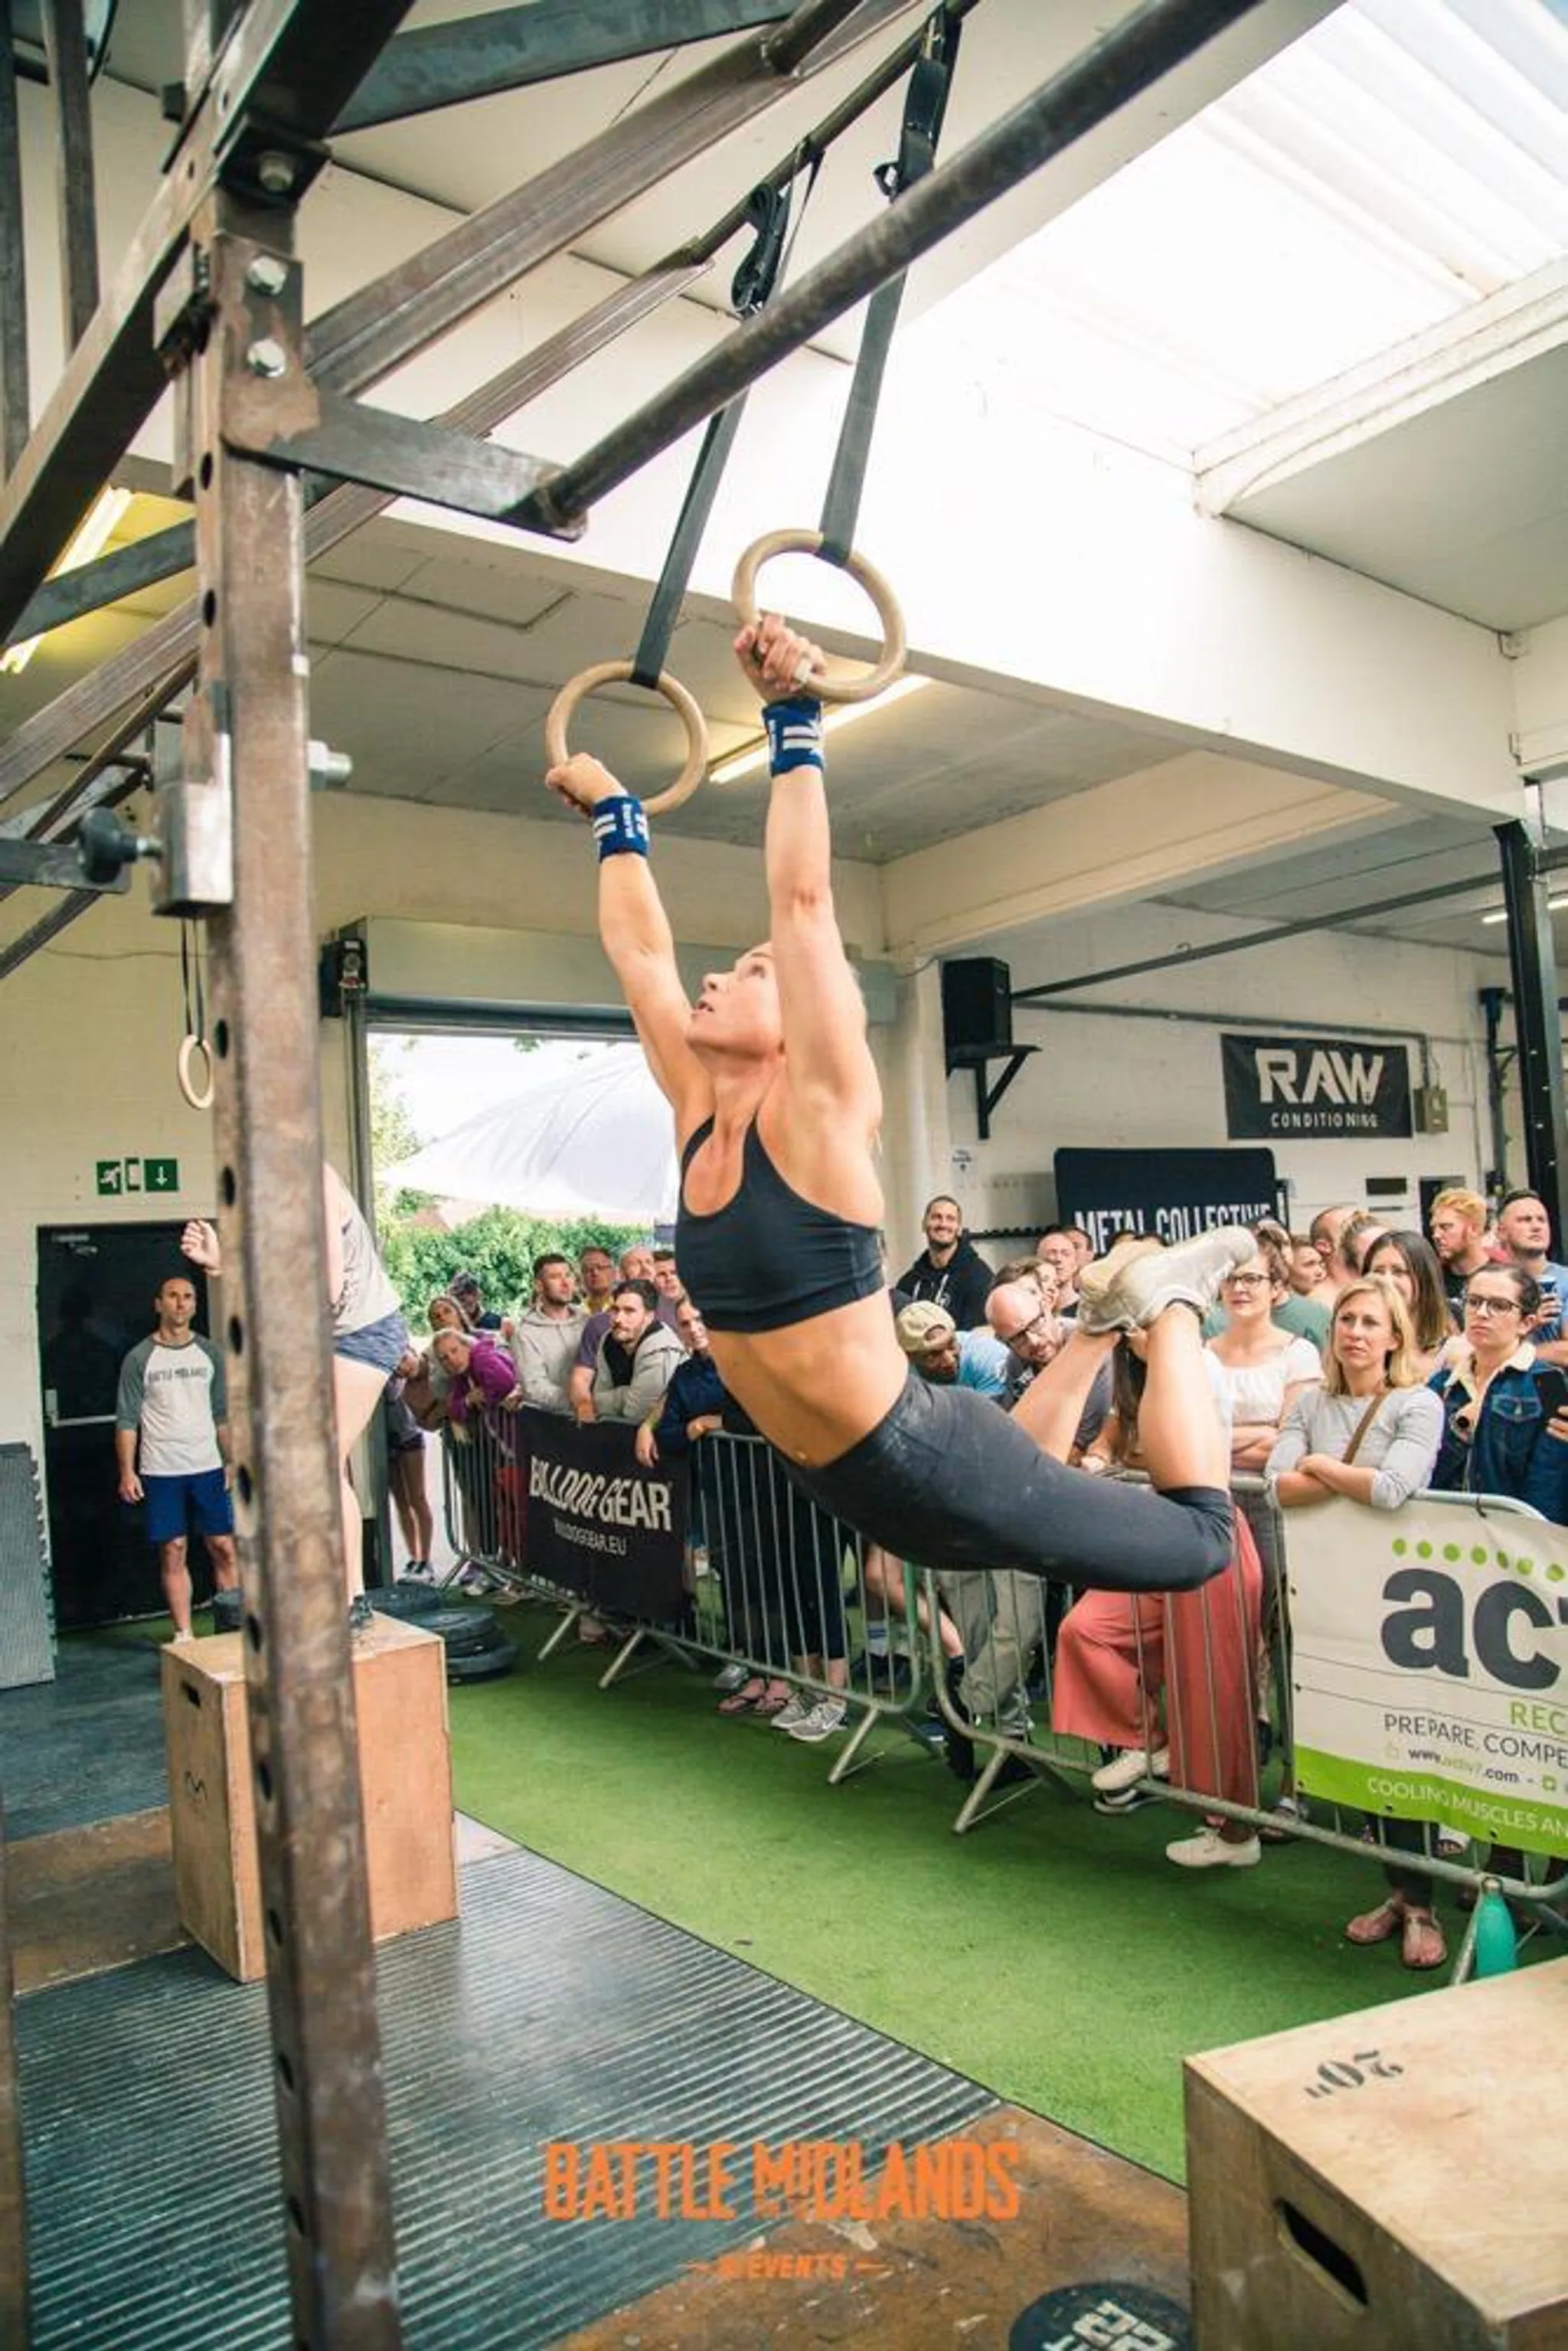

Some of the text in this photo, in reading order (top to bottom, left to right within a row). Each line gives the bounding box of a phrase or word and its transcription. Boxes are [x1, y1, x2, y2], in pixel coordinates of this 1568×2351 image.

[1256, 1048, 1383, 1105] RAW
[1270, 1112, 1379, 1129] CONDITIONING
[1156, 1204, 1271, 1244] COLLEC
[599, 1476, 671, 1532] GEAR
[1382, 1568, 1568, 1690] ac
[1452, 1793, 1538, 1832] MUSCLES
